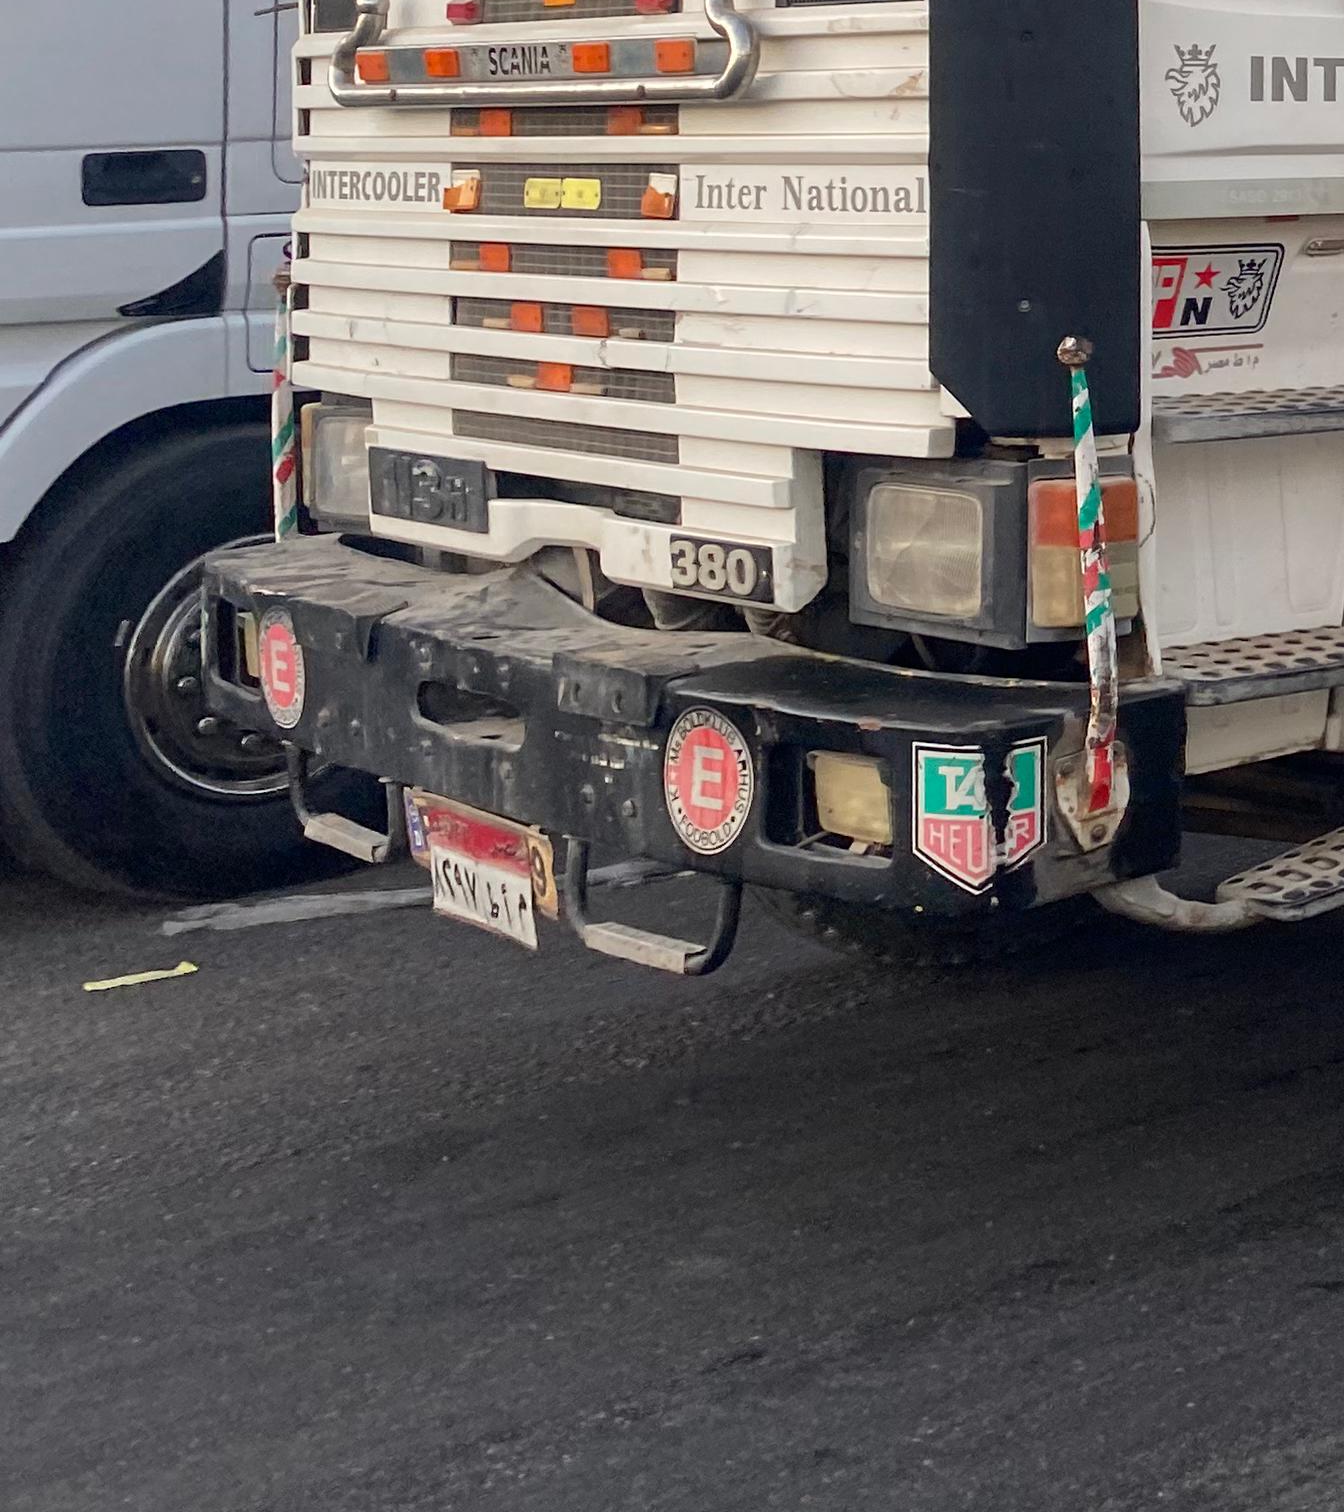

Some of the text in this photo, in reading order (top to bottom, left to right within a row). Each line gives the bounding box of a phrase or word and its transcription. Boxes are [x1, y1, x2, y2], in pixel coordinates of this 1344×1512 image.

[488, 46, 551, 76] SCANIA
[311, 170, 441, 203] INTERCOOLER
[694, 173, 927, 214] Inter National
[668, 538, 757, 599] 380
[929, 817, 1030, 874] HEUR
